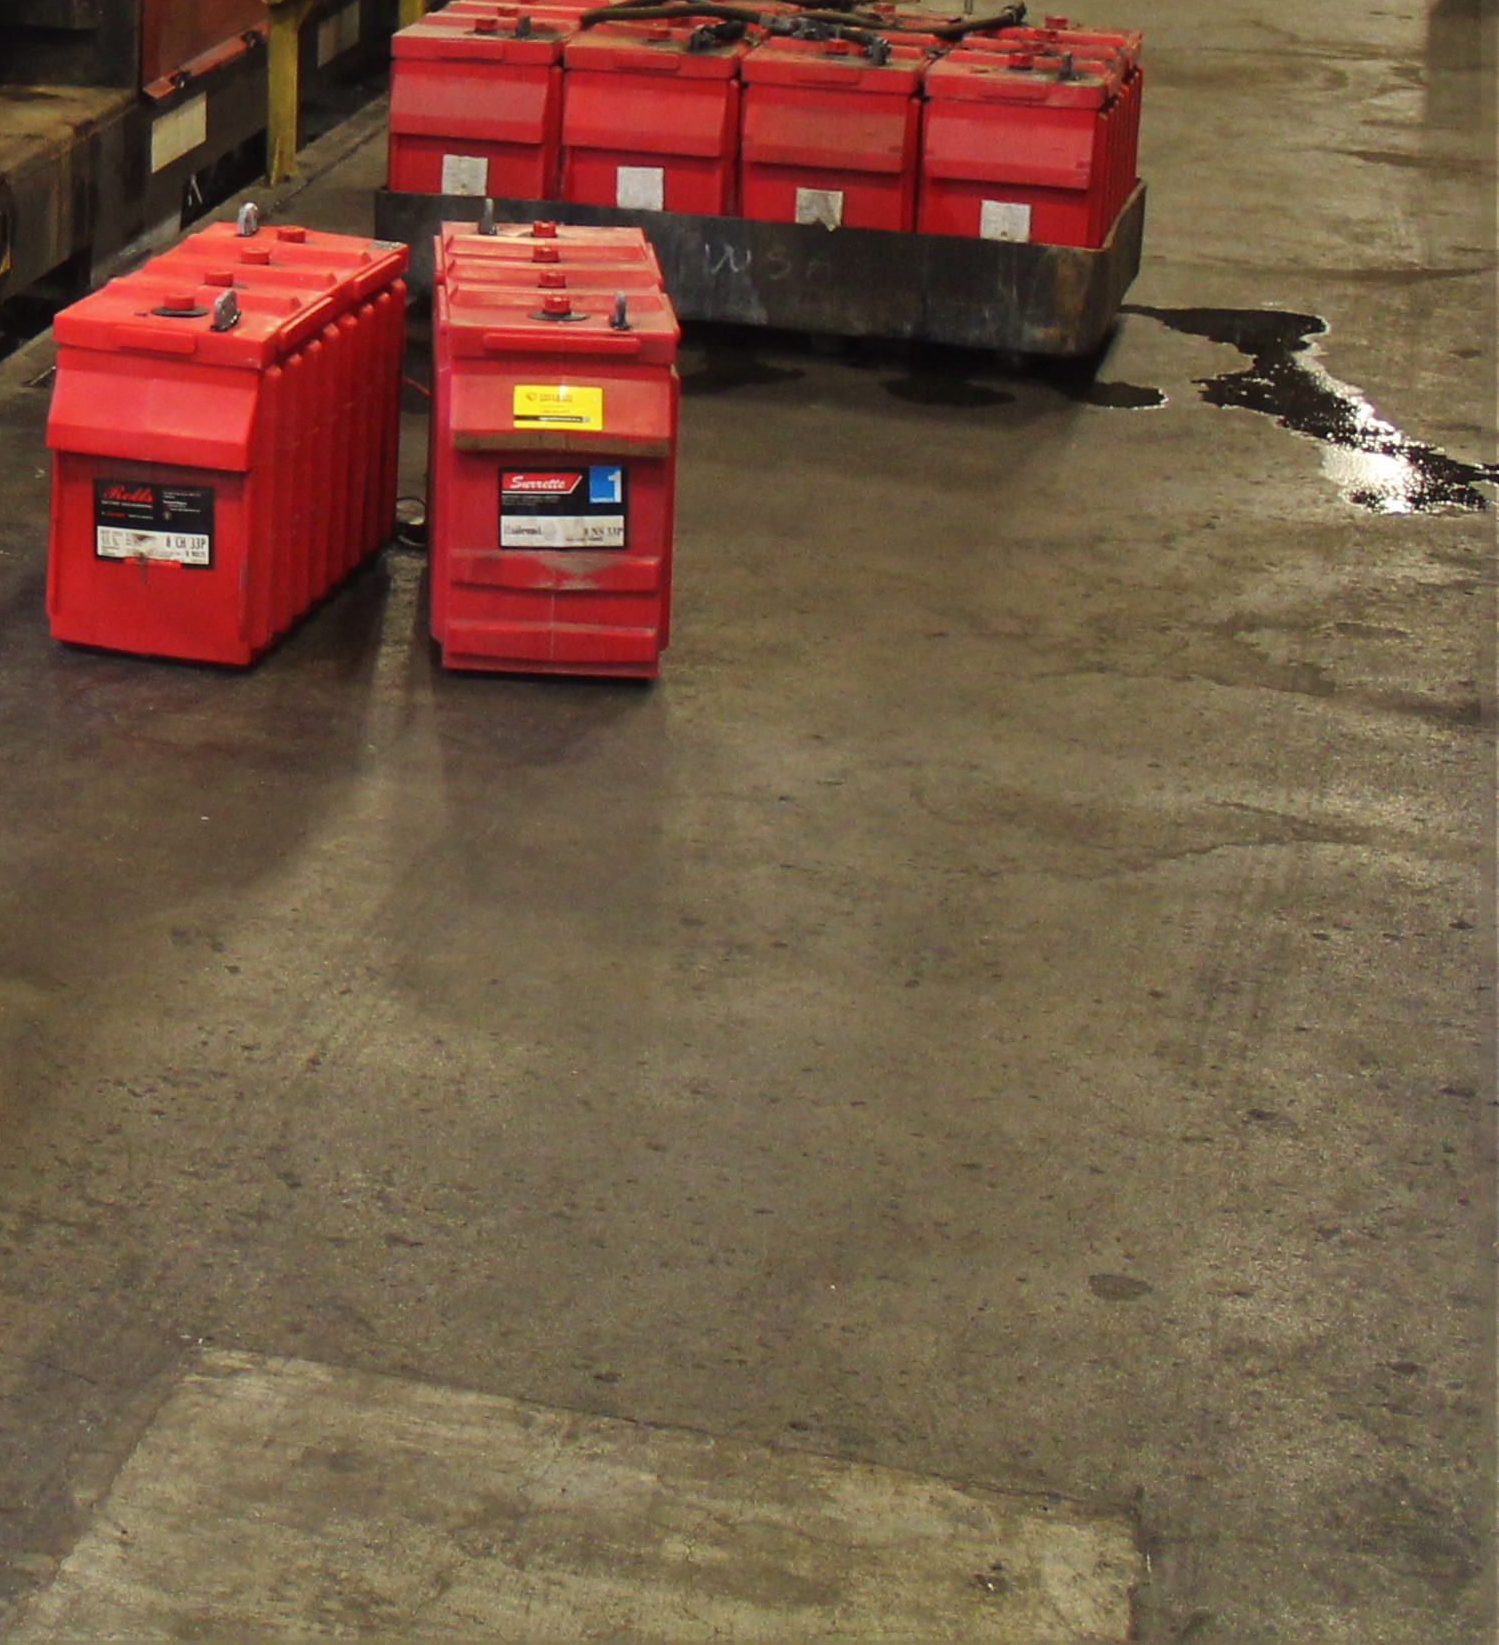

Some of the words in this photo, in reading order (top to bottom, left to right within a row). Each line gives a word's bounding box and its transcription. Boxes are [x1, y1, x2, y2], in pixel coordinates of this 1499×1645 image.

[509, 475, 566, 490] Surrette
[103, 485, 153, 503] Rolls
[190, 538, 206, 551] 33P
